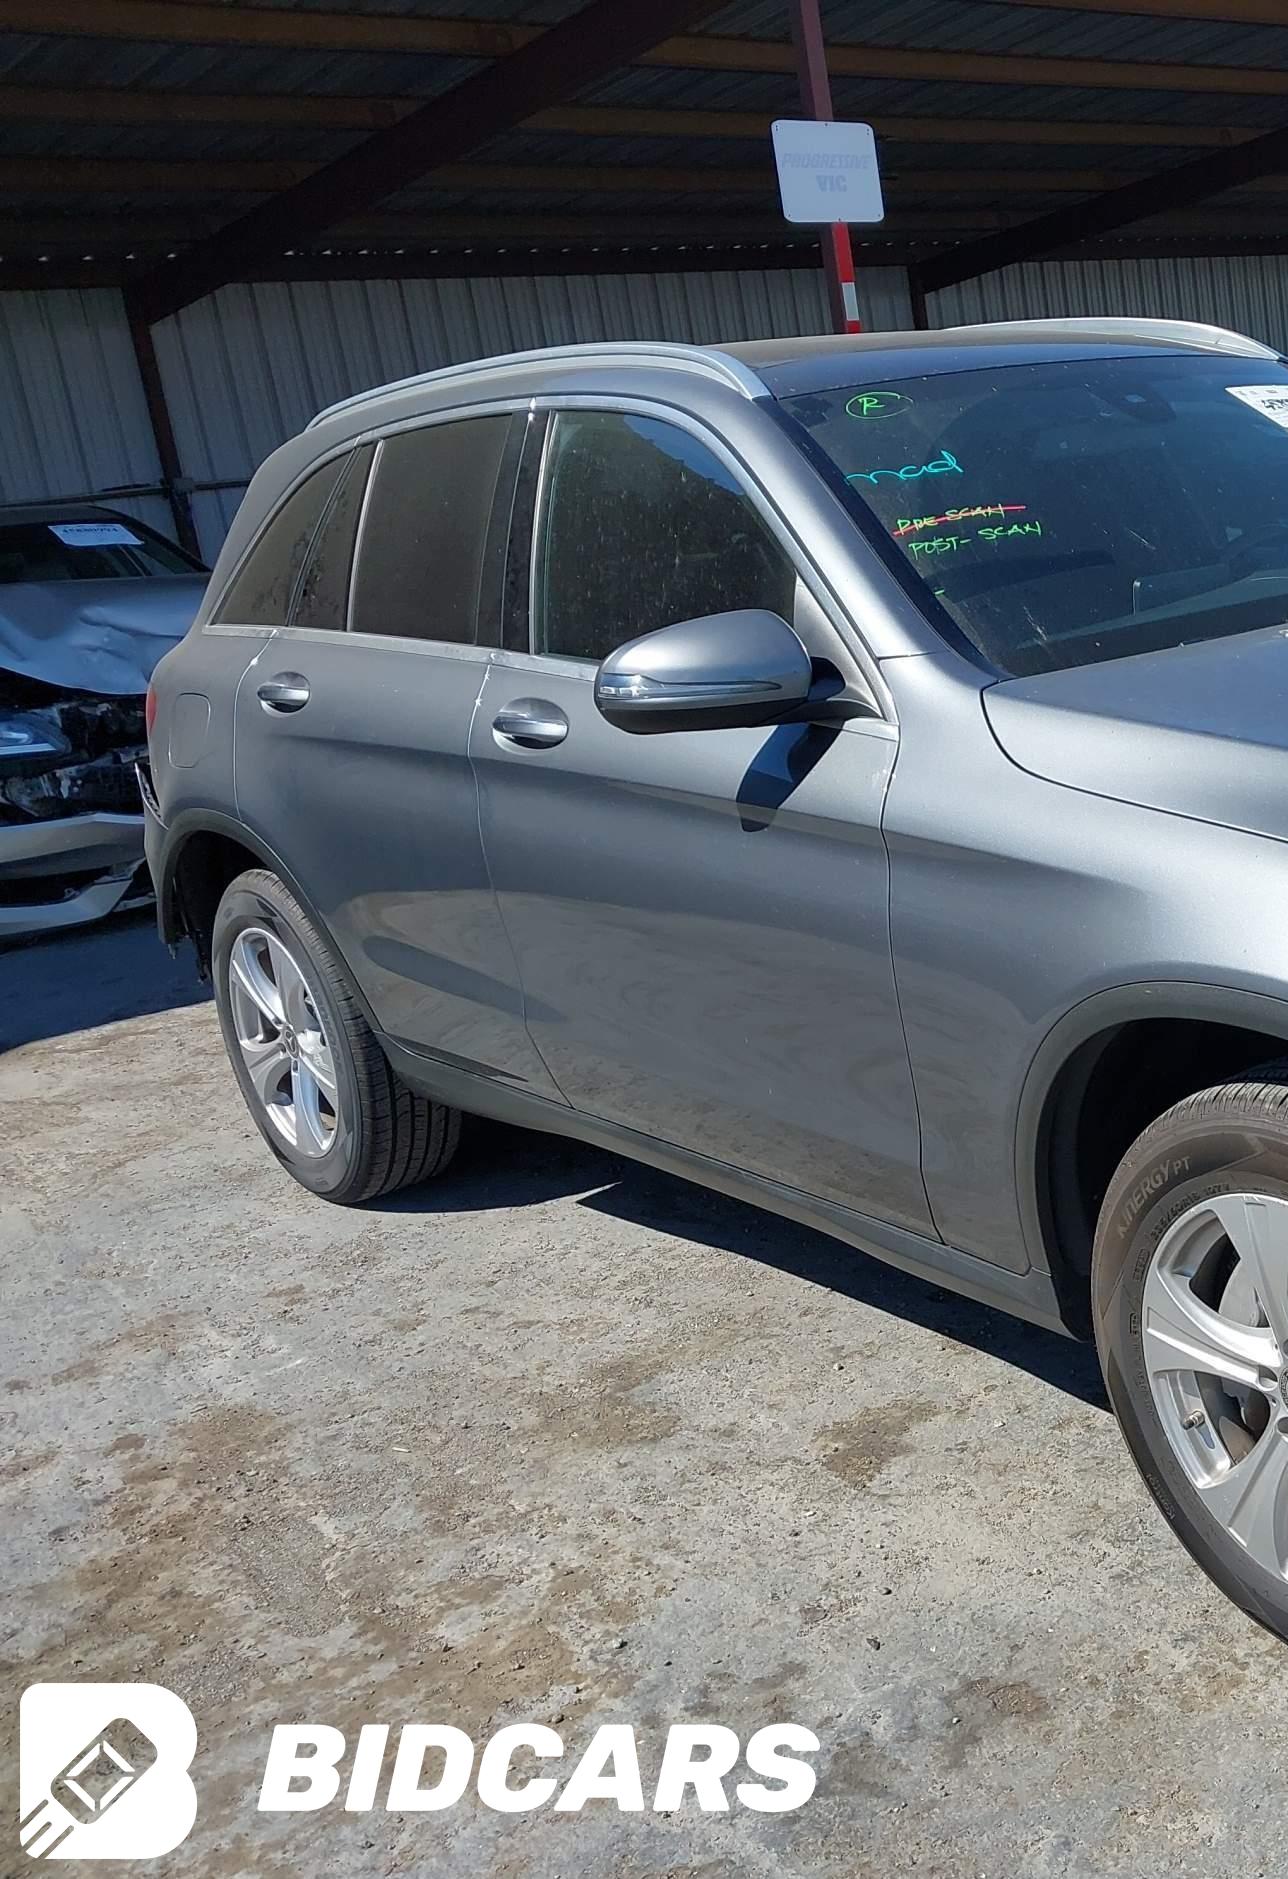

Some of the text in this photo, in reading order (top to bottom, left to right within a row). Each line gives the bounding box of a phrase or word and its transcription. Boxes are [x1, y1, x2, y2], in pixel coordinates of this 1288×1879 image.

[782, 152, 873, 169] PROGRESSIVE
[815, 174, 847, 192] VIC
[977, 521, 1042, 541] SCAN
[1172, 1156, 1192, 1176] PT
